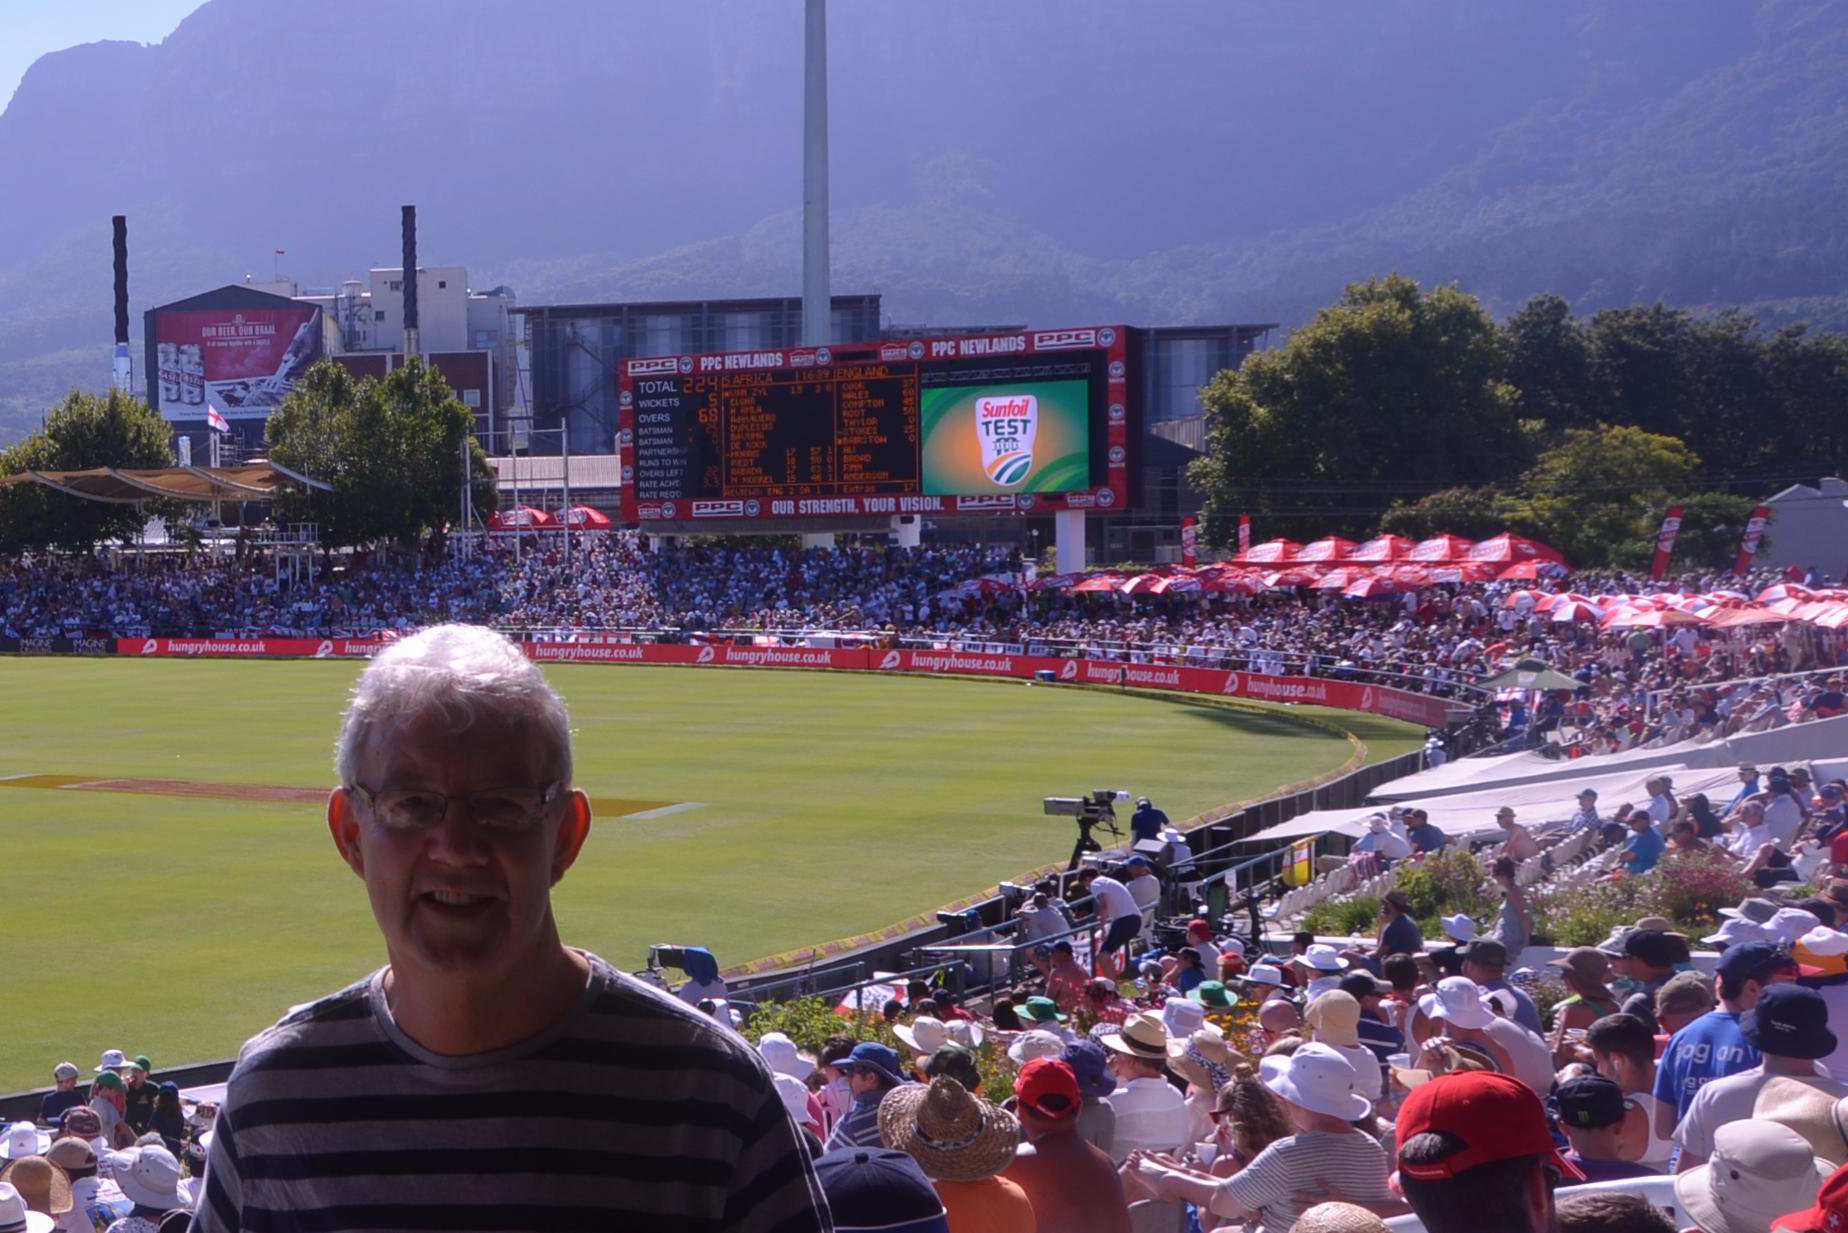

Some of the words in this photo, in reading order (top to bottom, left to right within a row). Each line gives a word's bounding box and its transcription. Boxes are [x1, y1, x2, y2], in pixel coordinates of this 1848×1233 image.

[932, 342, 955, 357] PPC
[960, 336, 1026, 356] NEWLANDS
[1036, 332, 1093, 344] PPC
[631, 360, 675, 371] PPC
[701, 356, 722, 370] PPC
[725, 353, 782, 370] NEWLANDS
[638, 381, 677, 394] TOTAL
[638, 398, 680, 408] WICKETS
[982, 399, 1030, 418] Sunfoil
[638, 414, 670, 423] OVERS
[981, 419, 1031, 436] TEST
[695, 502, 742, 512] PPC
[772, 501, 795, 514] OUR
[799, 499, 860, 514] STRENGTH,
[864, 498, 896, 512] YOUR
[900, 496, 945, 512] VISION.
[168, 640, 265, 655] hungryhouse.co.uk
[536, 645, 642, 663] hungryhouse.co.uk
[726, 648, 831, 665] hungryhouse.co.uk
[912, 652, 1012, 672] hungryhouse.co.uk
